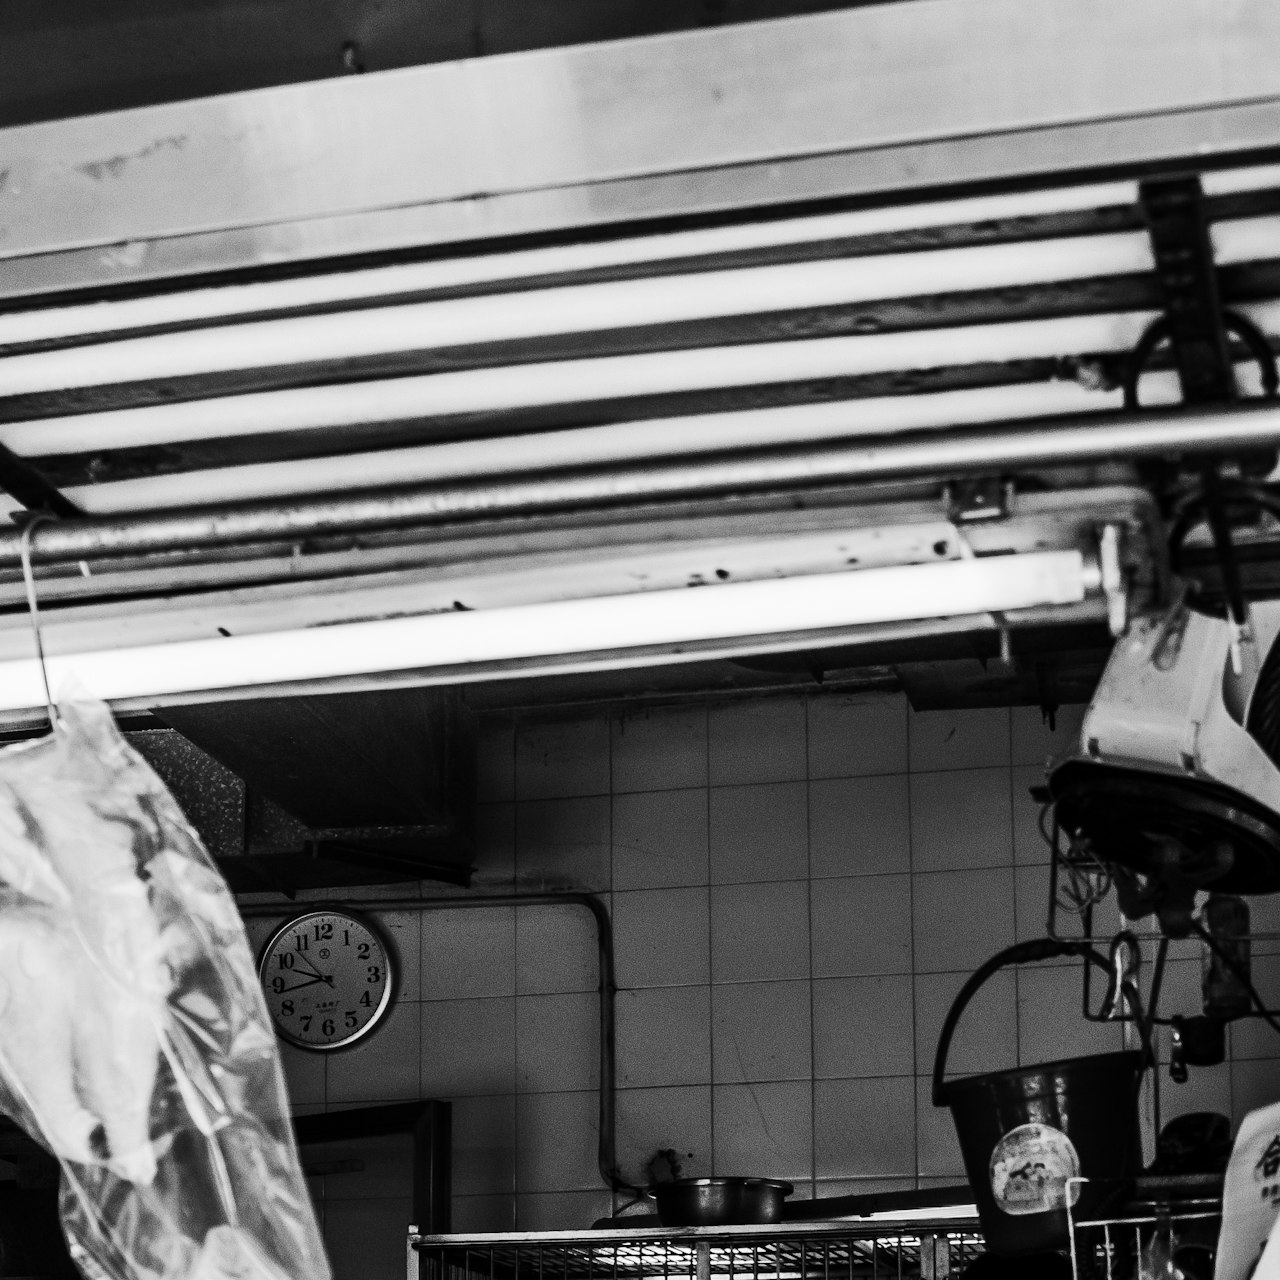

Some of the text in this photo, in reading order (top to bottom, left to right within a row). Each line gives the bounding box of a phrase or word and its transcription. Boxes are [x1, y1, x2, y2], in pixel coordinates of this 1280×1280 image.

[314, 923, 333, 942] 12
[343, 930, 351, 946] 1
[295, 934, 309, 951] 11
[357, 943, 370, 960] 2
[278, 952, 295, 970] 10
[367, 966, 380, 983] 3
[272, 976, 285, 994] 9
[359, 990, 372, 1008] 4
[281, 1000, 295, 1017] 8
[300, 1015, 313, 1032] 7
[322, 1019, 336, 1036] 6
[344, 1010, 358, 1028] 5
